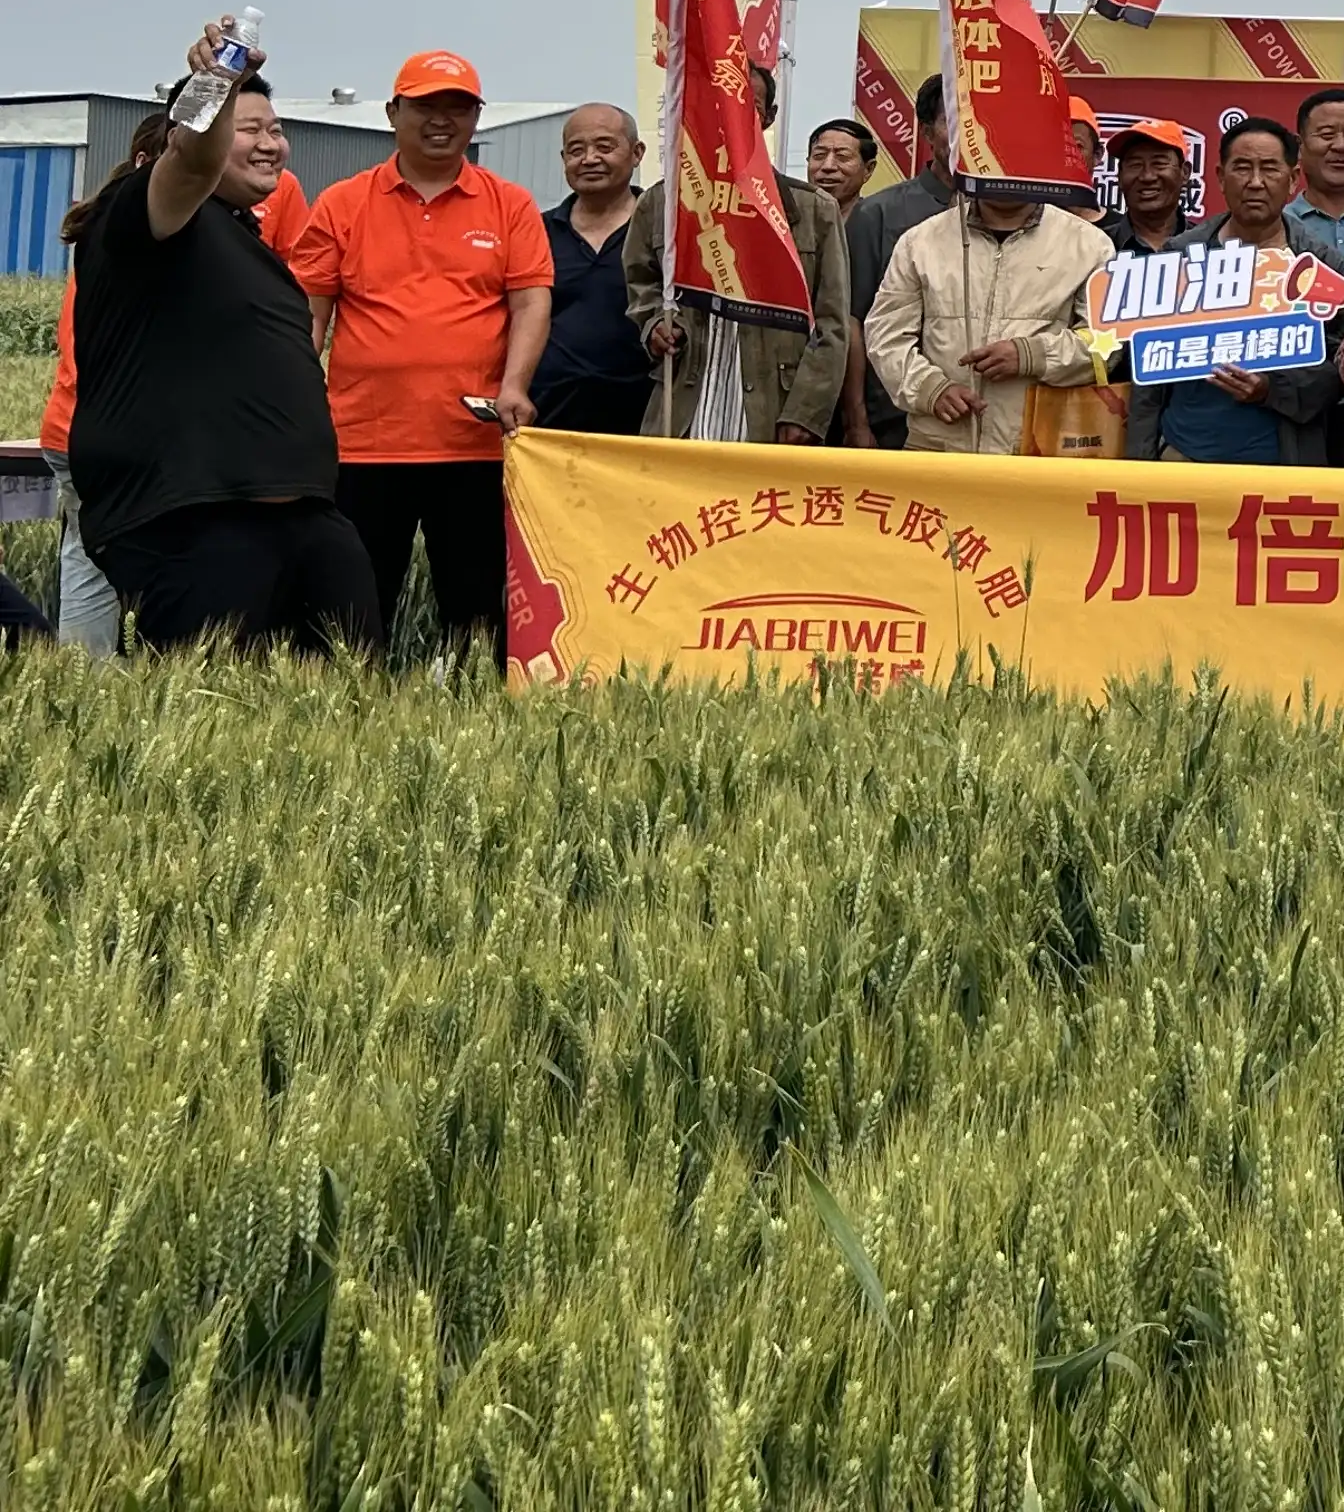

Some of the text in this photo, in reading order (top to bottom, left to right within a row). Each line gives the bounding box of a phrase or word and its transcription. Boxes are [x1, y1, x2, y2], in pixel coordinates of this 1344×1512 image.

[963, 118, 991, 176] DOUBLE
[708, 239, 735, 296] DOUBLE
[1103, 238, 1258, 323] 加油
[1140, 325, 1314, 374] 你是最棒的
[604, 484, 1029, 619] 生物控失透气胶体肥
[681, 617, 927, 655] JIABEIWEI
